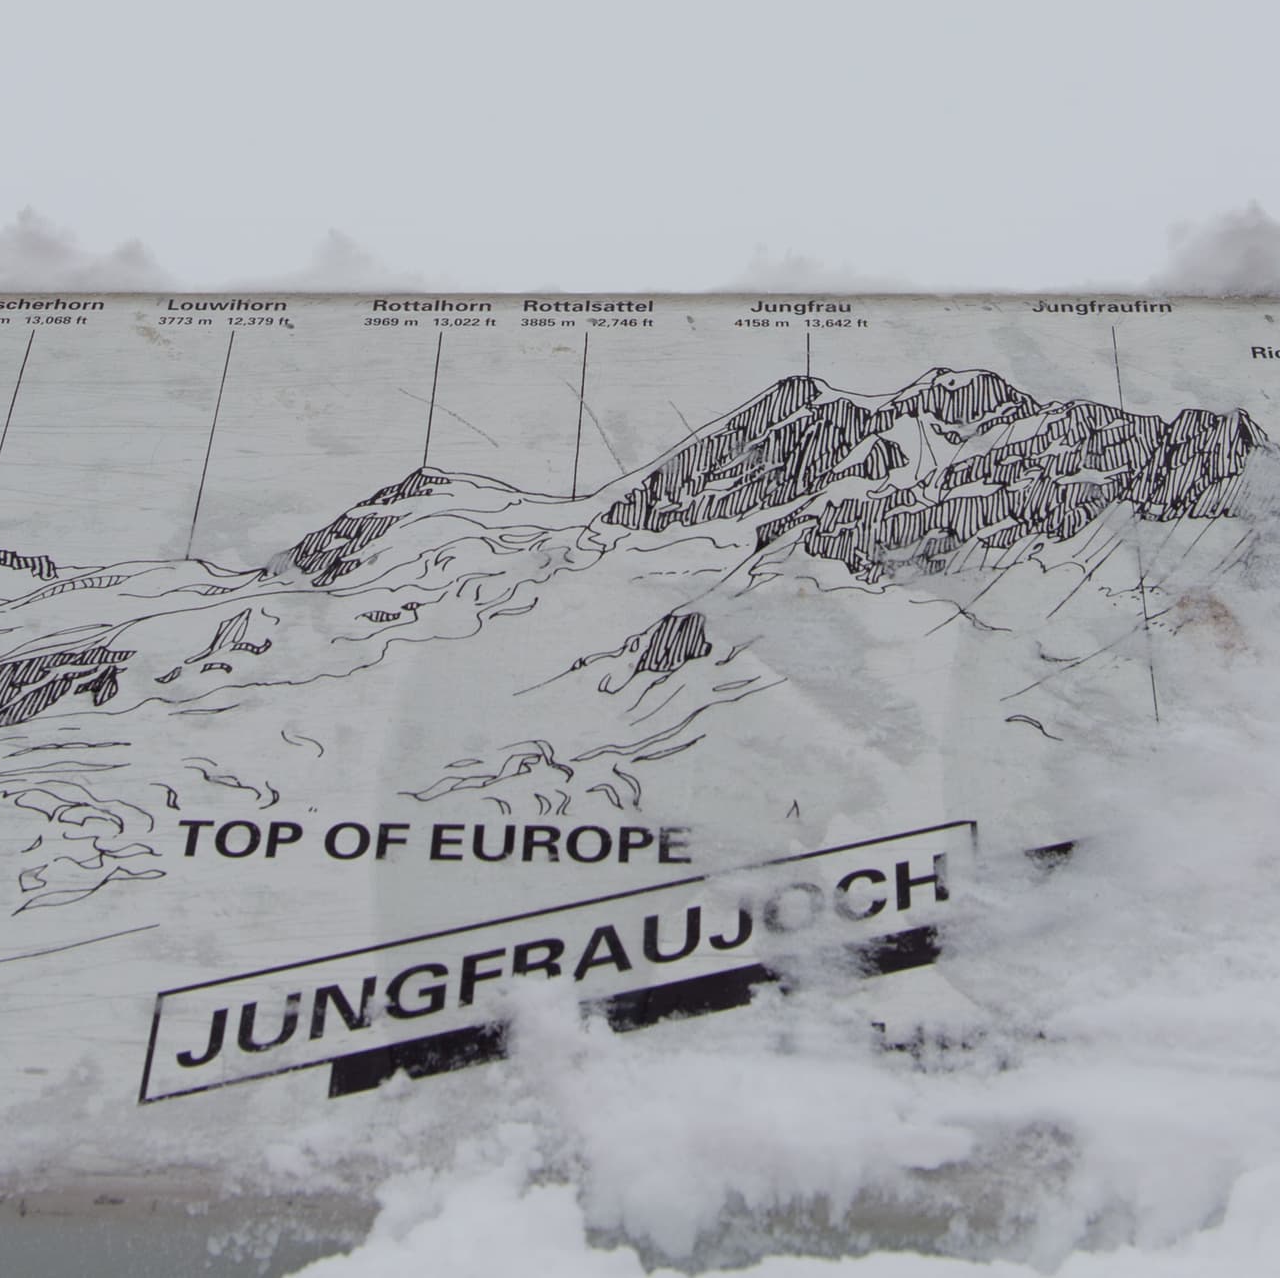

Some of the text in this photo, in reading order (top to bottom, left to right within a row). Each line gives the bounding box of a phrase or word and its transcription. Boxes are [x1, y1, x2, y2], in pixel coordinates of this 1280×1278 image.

[168, 299, 287, 311] Louwihorn
[373, 300, 492, 312] Rottalhorn
[523, 300, 653, 312] Rottalsattel
[751, 301, 851, 315] Jungfrau
[1032, 301, 1172, 315] Jungfraufirn
[25, 316, 71, 325] 13,068
[76, 316, 87, 324] ft
[158, 317, 193, 325] 3773
[228, 317, 274, 326] 12,379
[364, 318, 399, 326] 3969
[434, 318, 480, 327] 13,022
[486, 318, 496, 326] ft
[521, 318, 556, 327] 3885
[643, 318, 654, 327] ft
[735, 319, 770, 327] 4158
[805, 319, 851, 328] 13,642
[857, 319, 868, 327] ft
[179, 820, 692, 863] TOP OF EUROPE
[176, 833, 949, 1068] JUNGFRAUJOCH
